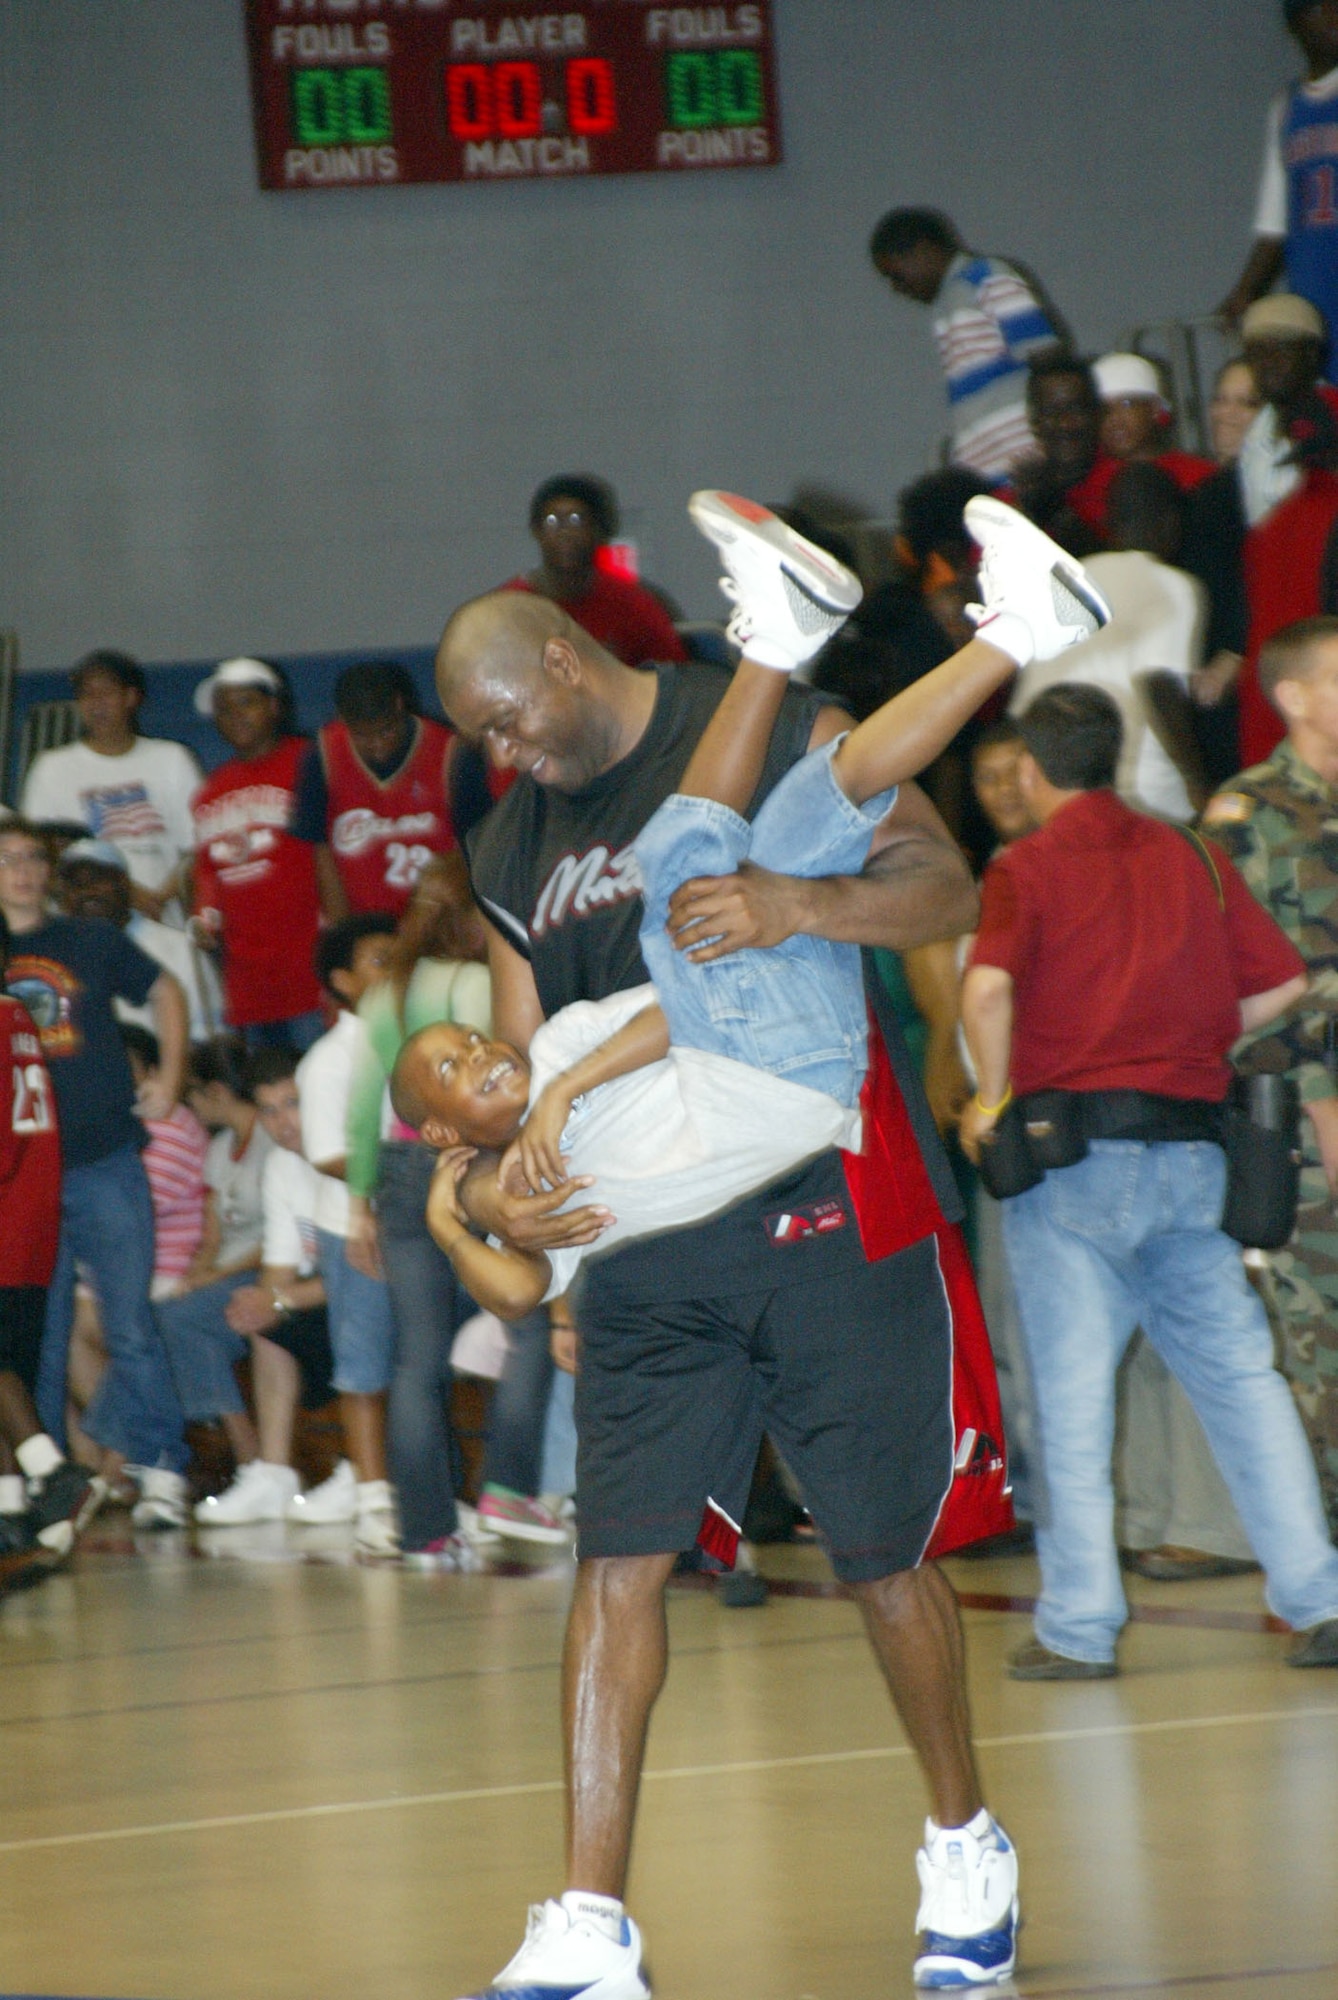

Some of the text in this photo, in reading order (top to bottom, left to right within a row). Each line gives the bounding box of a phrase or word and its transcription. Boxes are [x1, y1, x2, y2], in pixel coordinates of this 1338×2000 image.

[272, 21, 390, 61] FOULS
[451, 13, 587, 53] PLAYER
[645, 4, 762, 43] FOULS
[284, 146, 399, 182] POINTS
[463, 137, 591, 175] MATCH
[657, 127, 769, 165] POINTS
